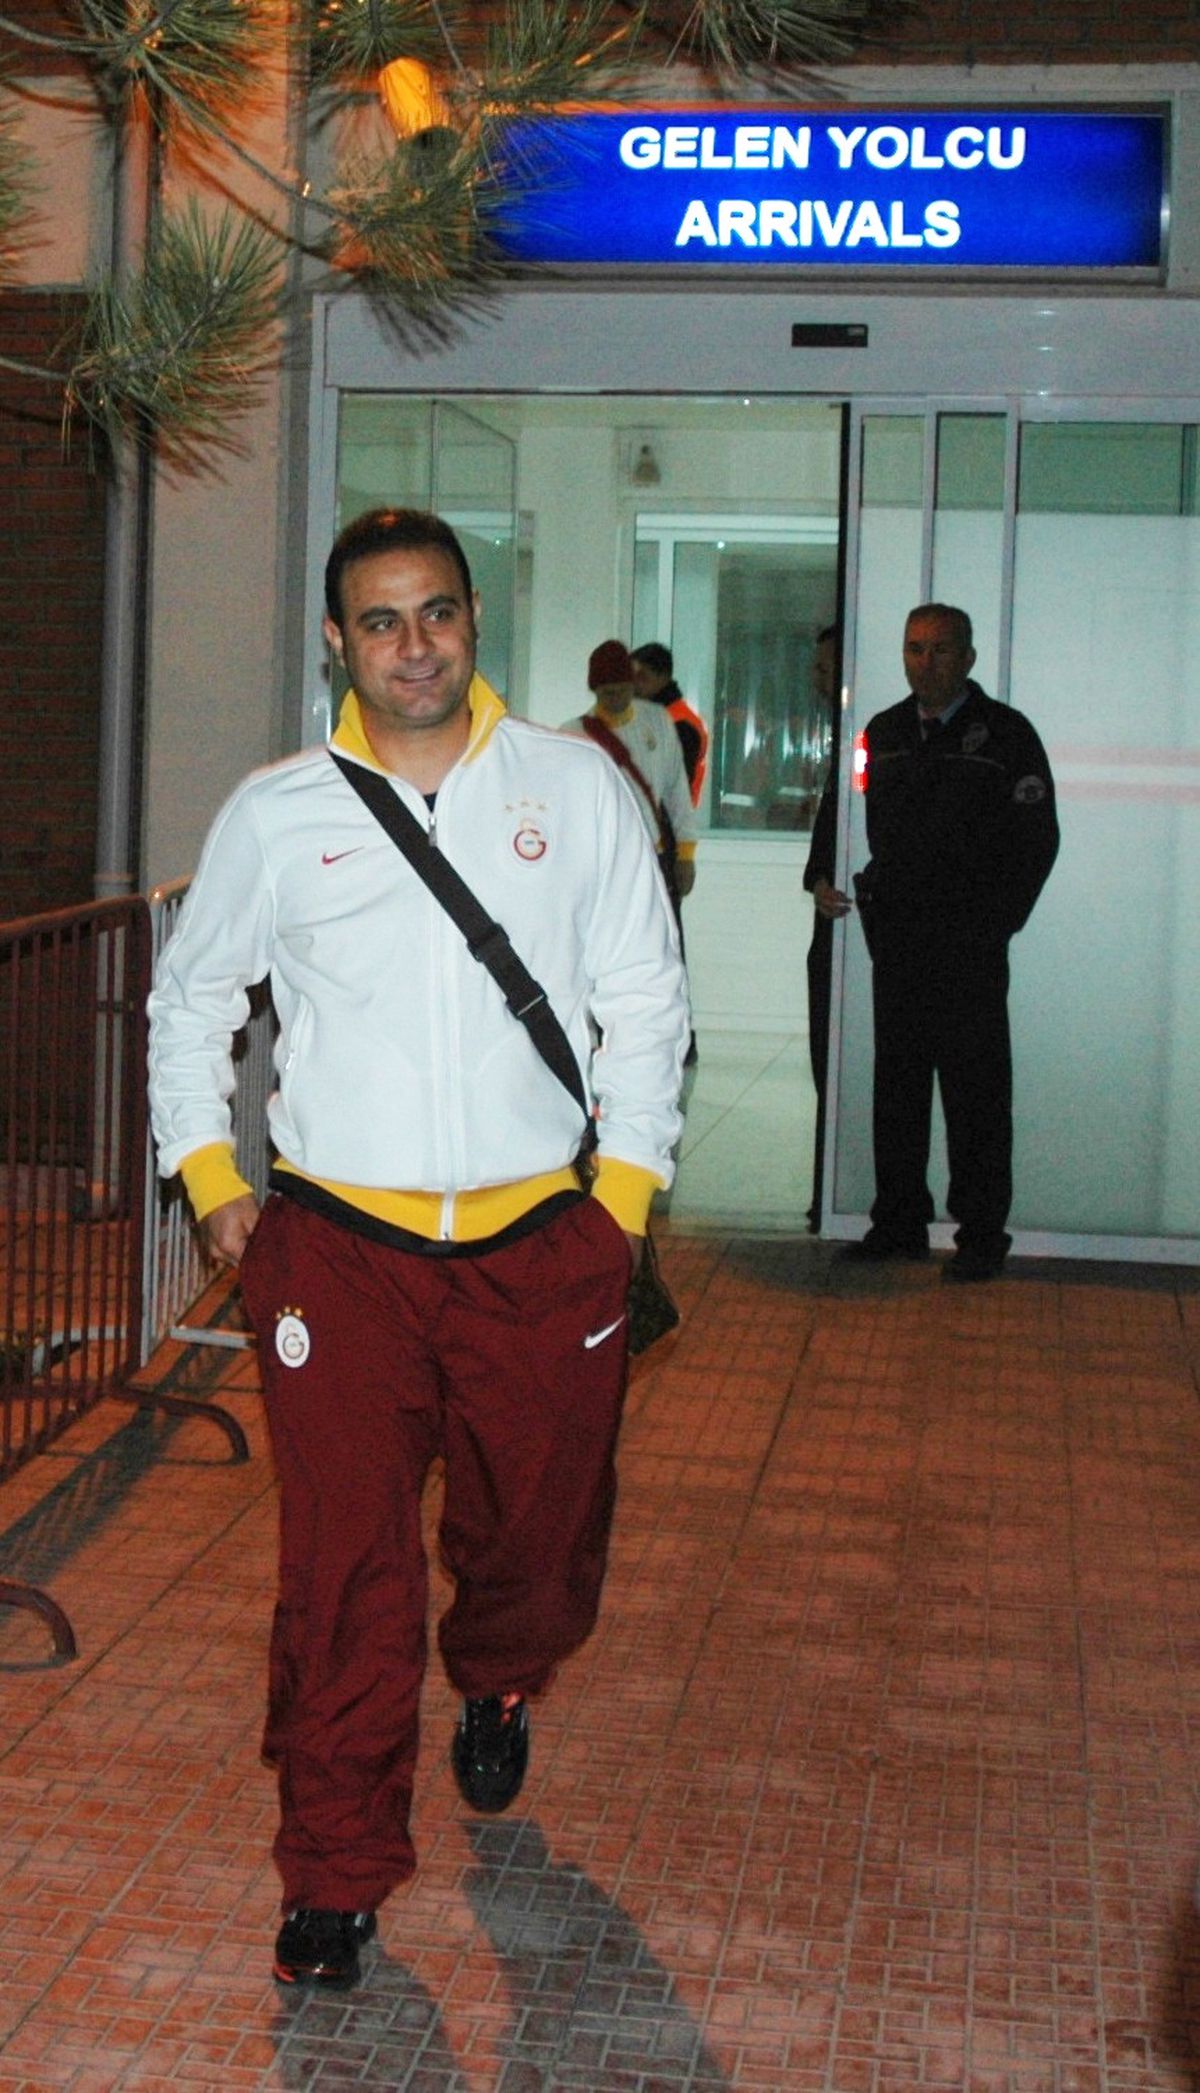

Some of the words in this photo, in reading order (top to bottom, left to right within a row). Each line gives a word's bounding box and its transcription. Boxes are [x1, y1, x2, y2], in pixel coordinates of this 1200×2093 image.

[618, 126, 811, 170] GELEN
[827, 126, 1026, 170] YOLCU
[675, 199, 961, 248] ARRIVALS
